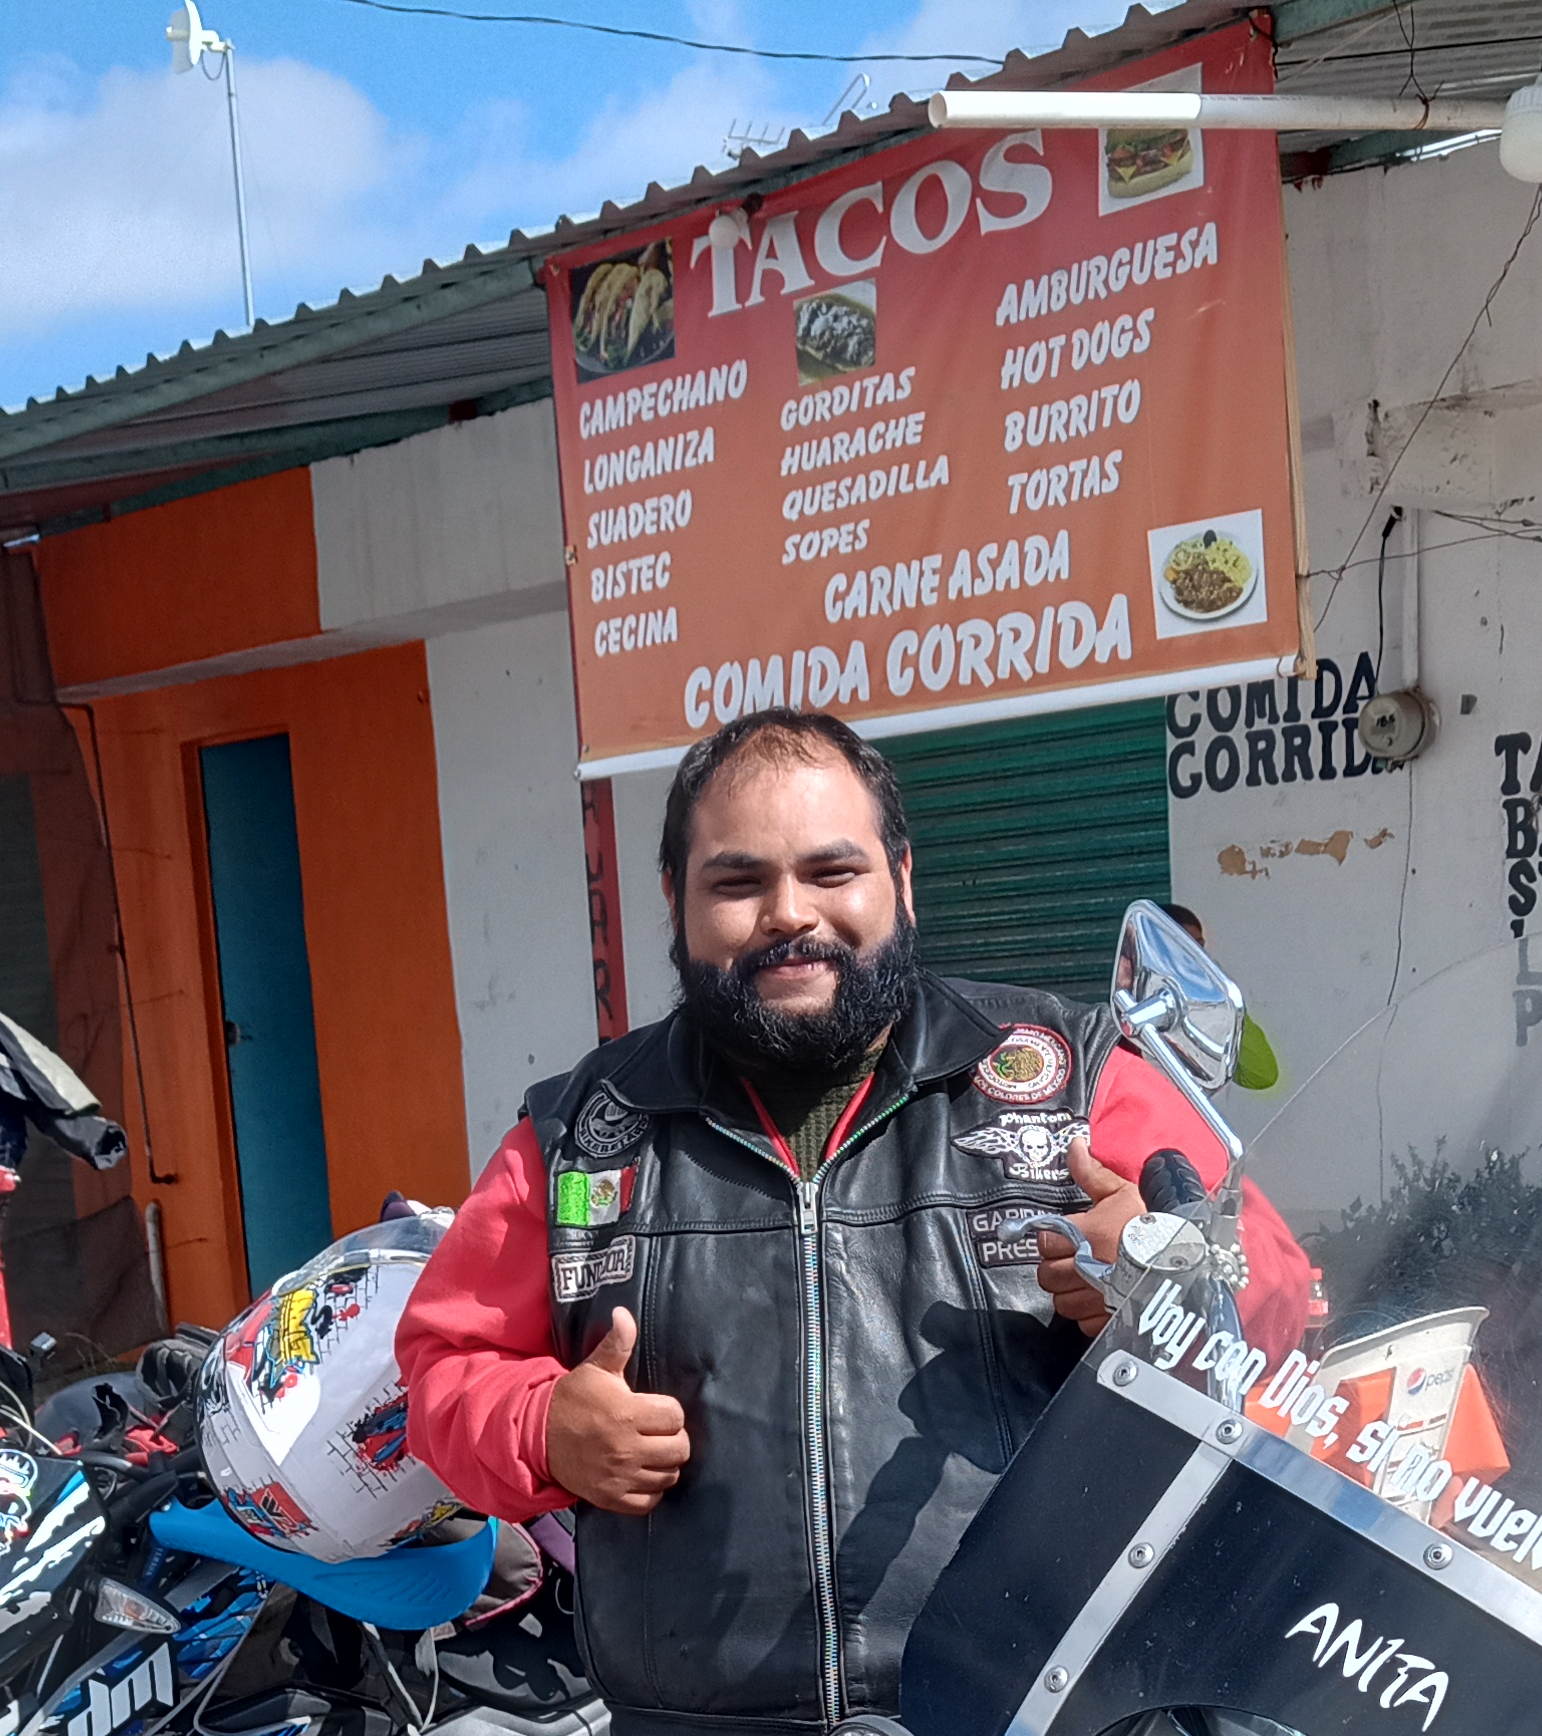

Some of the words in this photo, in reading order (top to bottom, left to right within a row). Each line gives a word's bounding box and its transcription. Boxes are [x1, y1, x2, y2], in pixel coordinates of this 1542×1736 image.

[689, 129, 1054, 319] TACOS
[995, 222, 1219, 327] AMBURGUESA
[1000, 326, 1064, 390] HOT
[1071, 308, 1155, 371] DOGS
[579, 360, 747, 439] CAMPECHANO
[781, 367, 915, 431] GORDITAS
[1003, 380, 1141, 453] BURRITO
[583, 428, 715, 494] LONGANIZA
[781, 411, 926, 476] HUARACHE
[587, 491, 692, 549] SUADERO
[781, 456, 949, 521] QUESADILLA
[1007, 450, 1122, 515] TORTAS
[591, 555, 671, 604] BISTEC
[781, 519, 870, 566] SOPES
[824, 557, 941, 624] CARNE
[947, 530, 1071, 603] ASADA
[595, 607, 678, 658] CECINA
[684, 644, 870, 728] COMIDA
[887, 594, 1133, 698] CORRIDA
[1167, 651, 1377, 739] COMIDA
[1168, 717, 1384, 799] CORRID
[1138, 1278, 1207, 1372] Voy
[1192, 1323, 1266, 1394] con
[1390, 1442, 1453, 1502] no
[1284, 1602, 1450, 1732] ANITA
